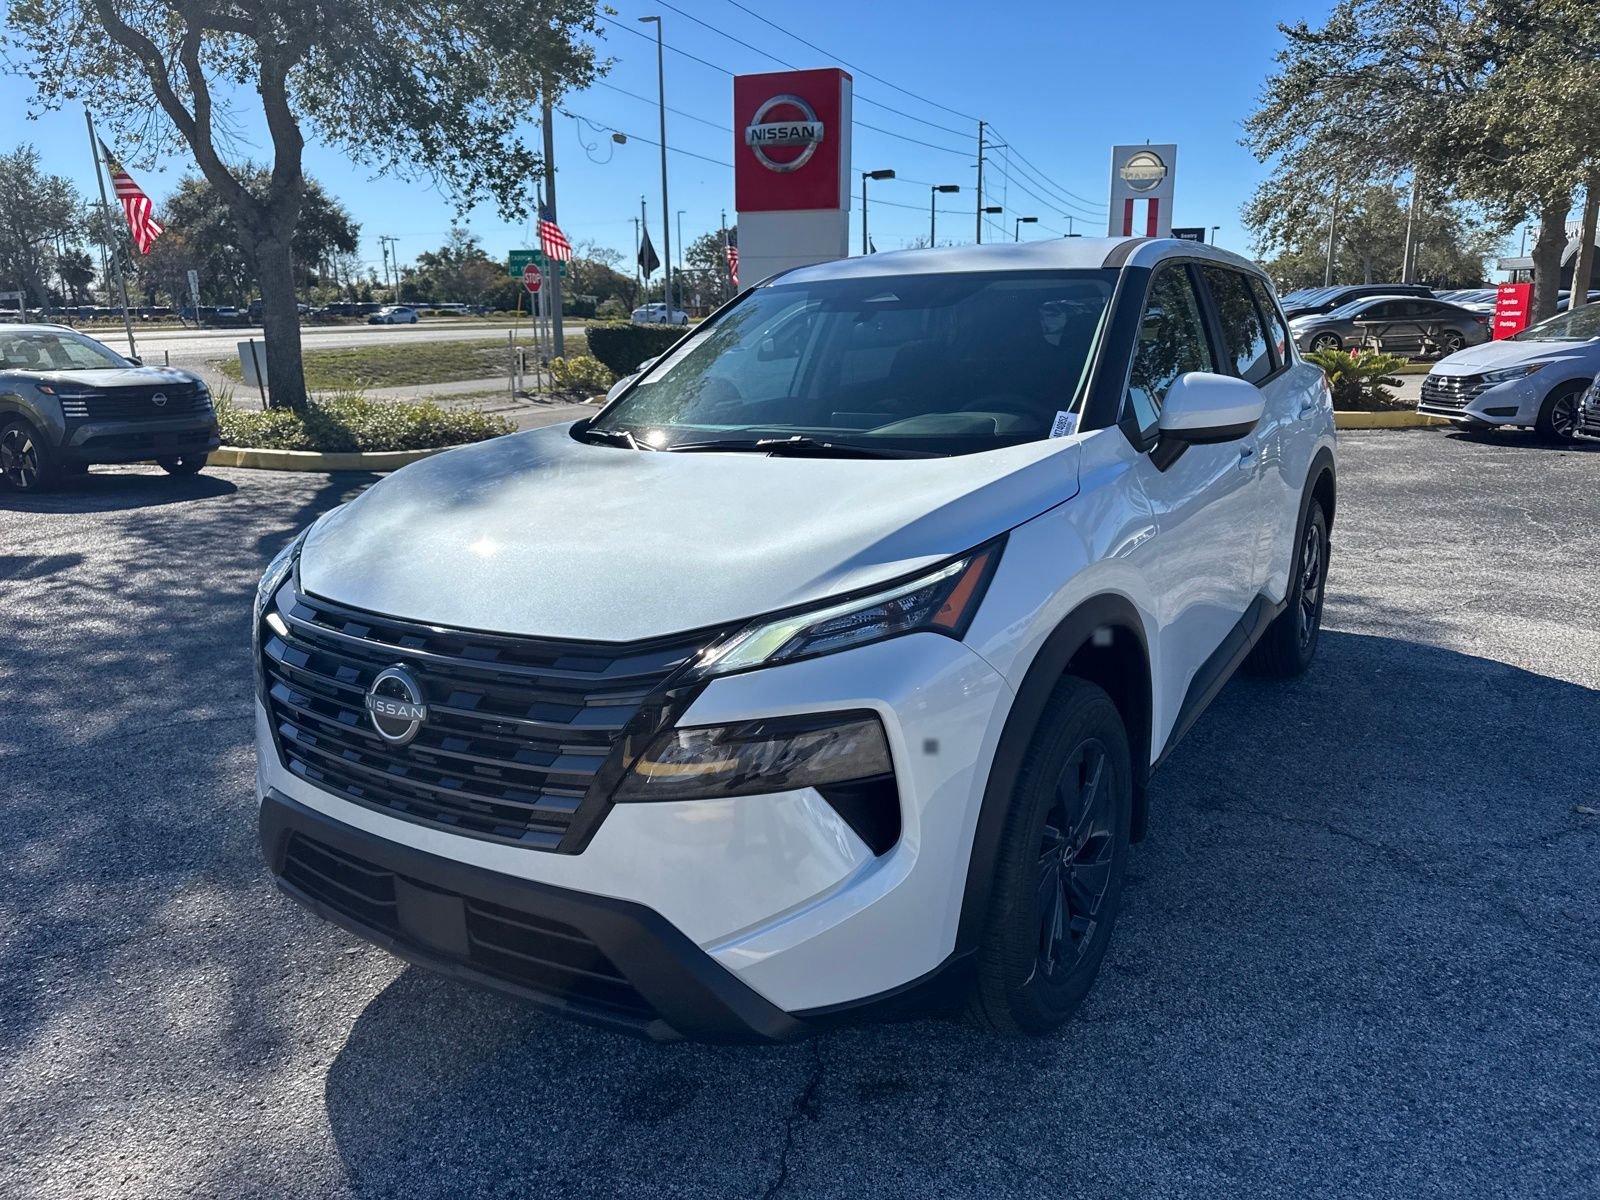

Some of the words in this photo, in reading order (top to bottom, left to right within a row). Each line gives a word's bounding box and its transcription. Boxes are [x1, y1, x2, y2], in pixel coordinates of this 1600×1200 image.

[751, 126, 815, 141] NISSAN
[525, 273, 541, 285] STOP
[1499, 320, 1517, 328] Parking
[365, 695, 424, 719] NISSAN
